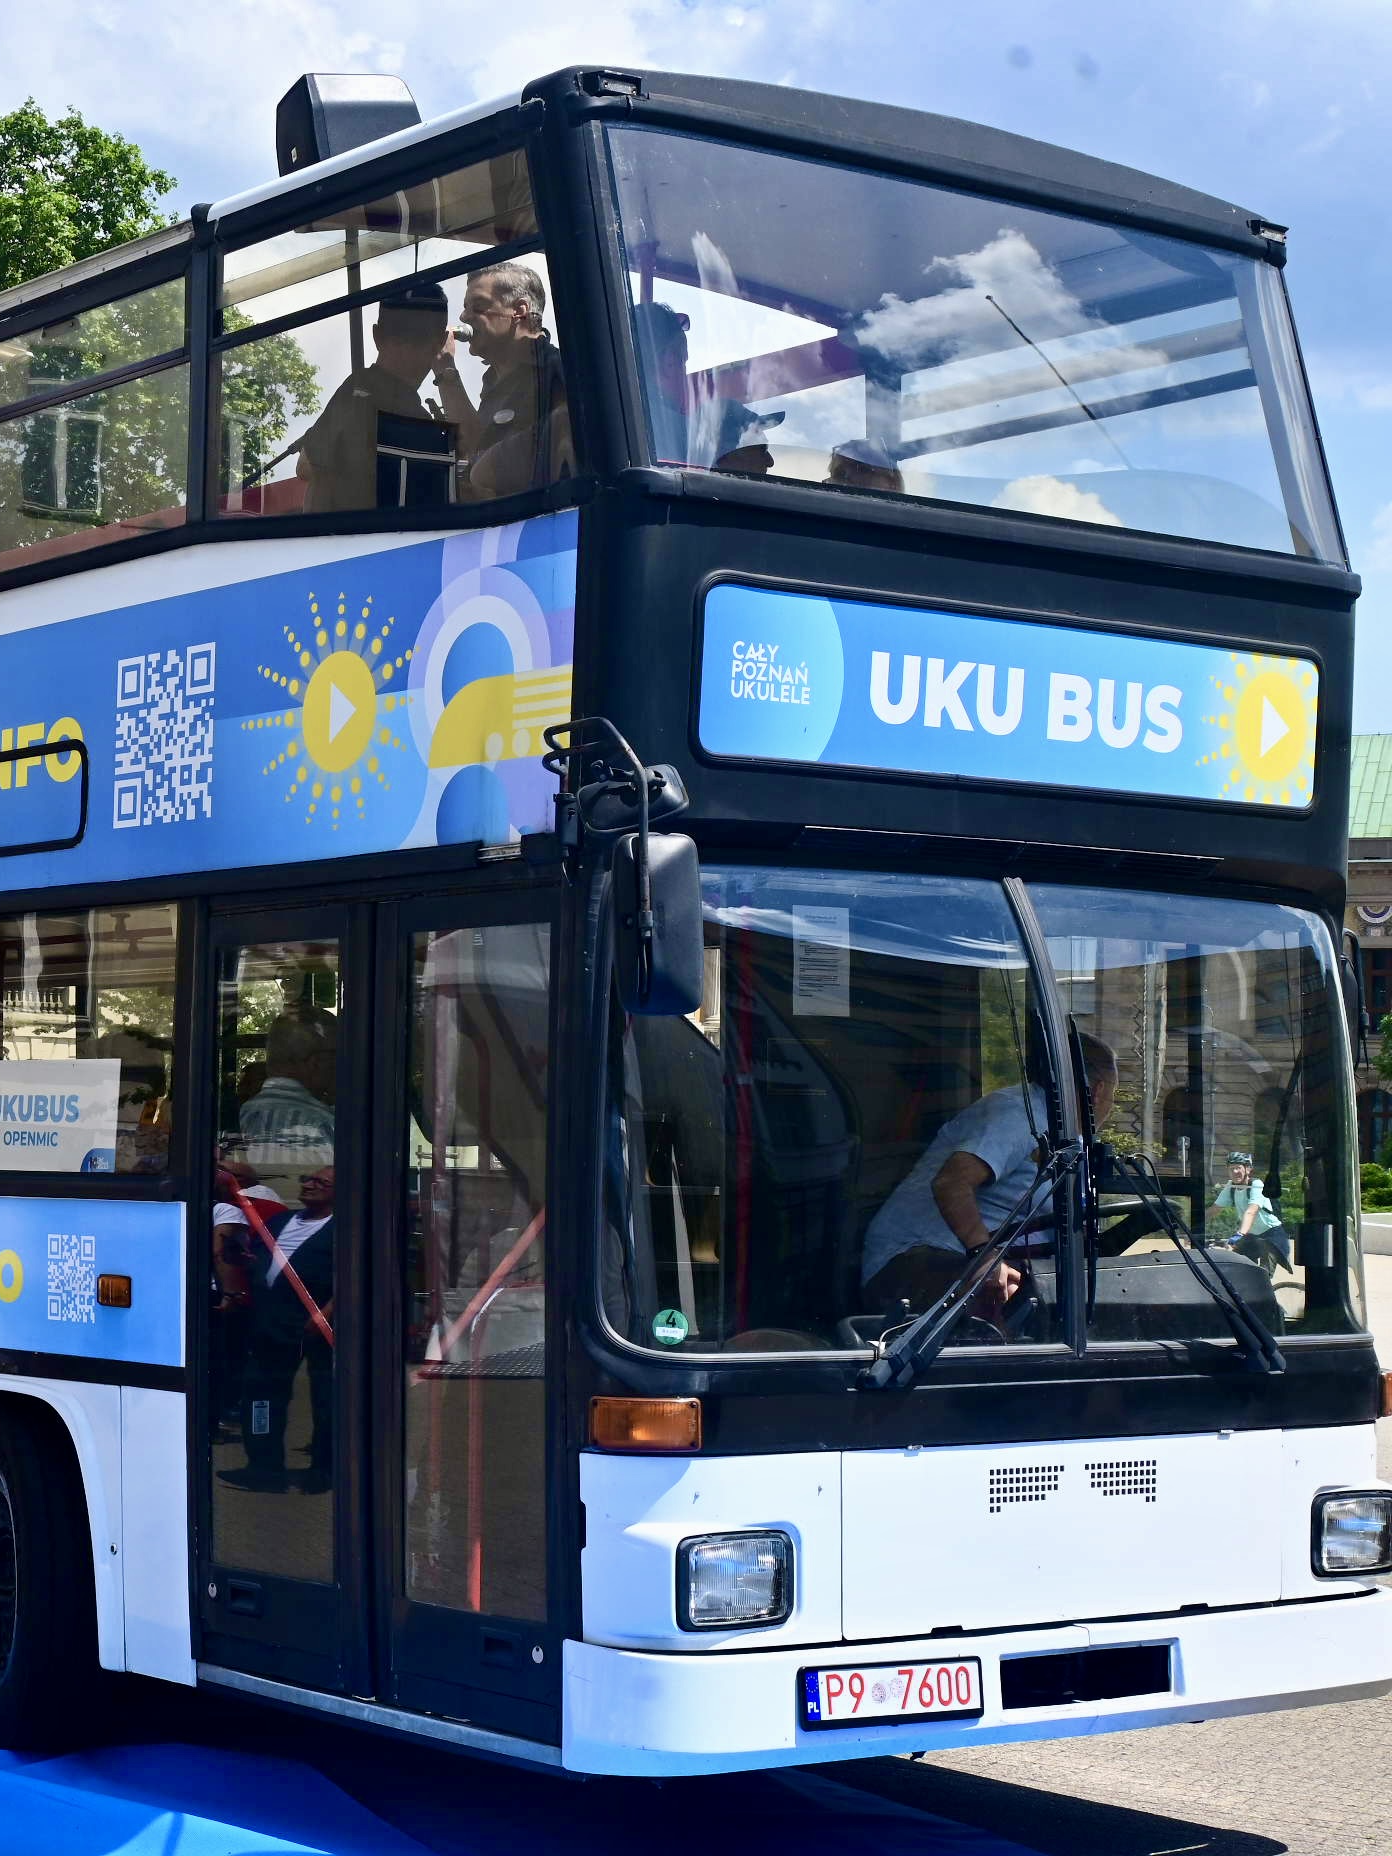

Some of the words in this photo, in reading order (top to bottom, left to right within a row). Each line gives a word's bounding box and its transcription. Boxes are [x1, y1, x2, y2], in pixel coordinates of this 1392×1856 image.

[732, 640, 780, 663] CAŁY
[731, 659, 809, 686] POZNAŃ
[730, 679, 811, 705] UKULELE
[869, 650, 1025, 736] UKU
[1046, 672, 1184, 754] BUS
[3, 1131, 59, 1147] OPENMIC
[665, 1310, 676, 1327] 4
[825, 1673, 864, 1715] P9
[898, 1666, 971, 1709] 7600
[807, 1701, 820, 1714] PL
